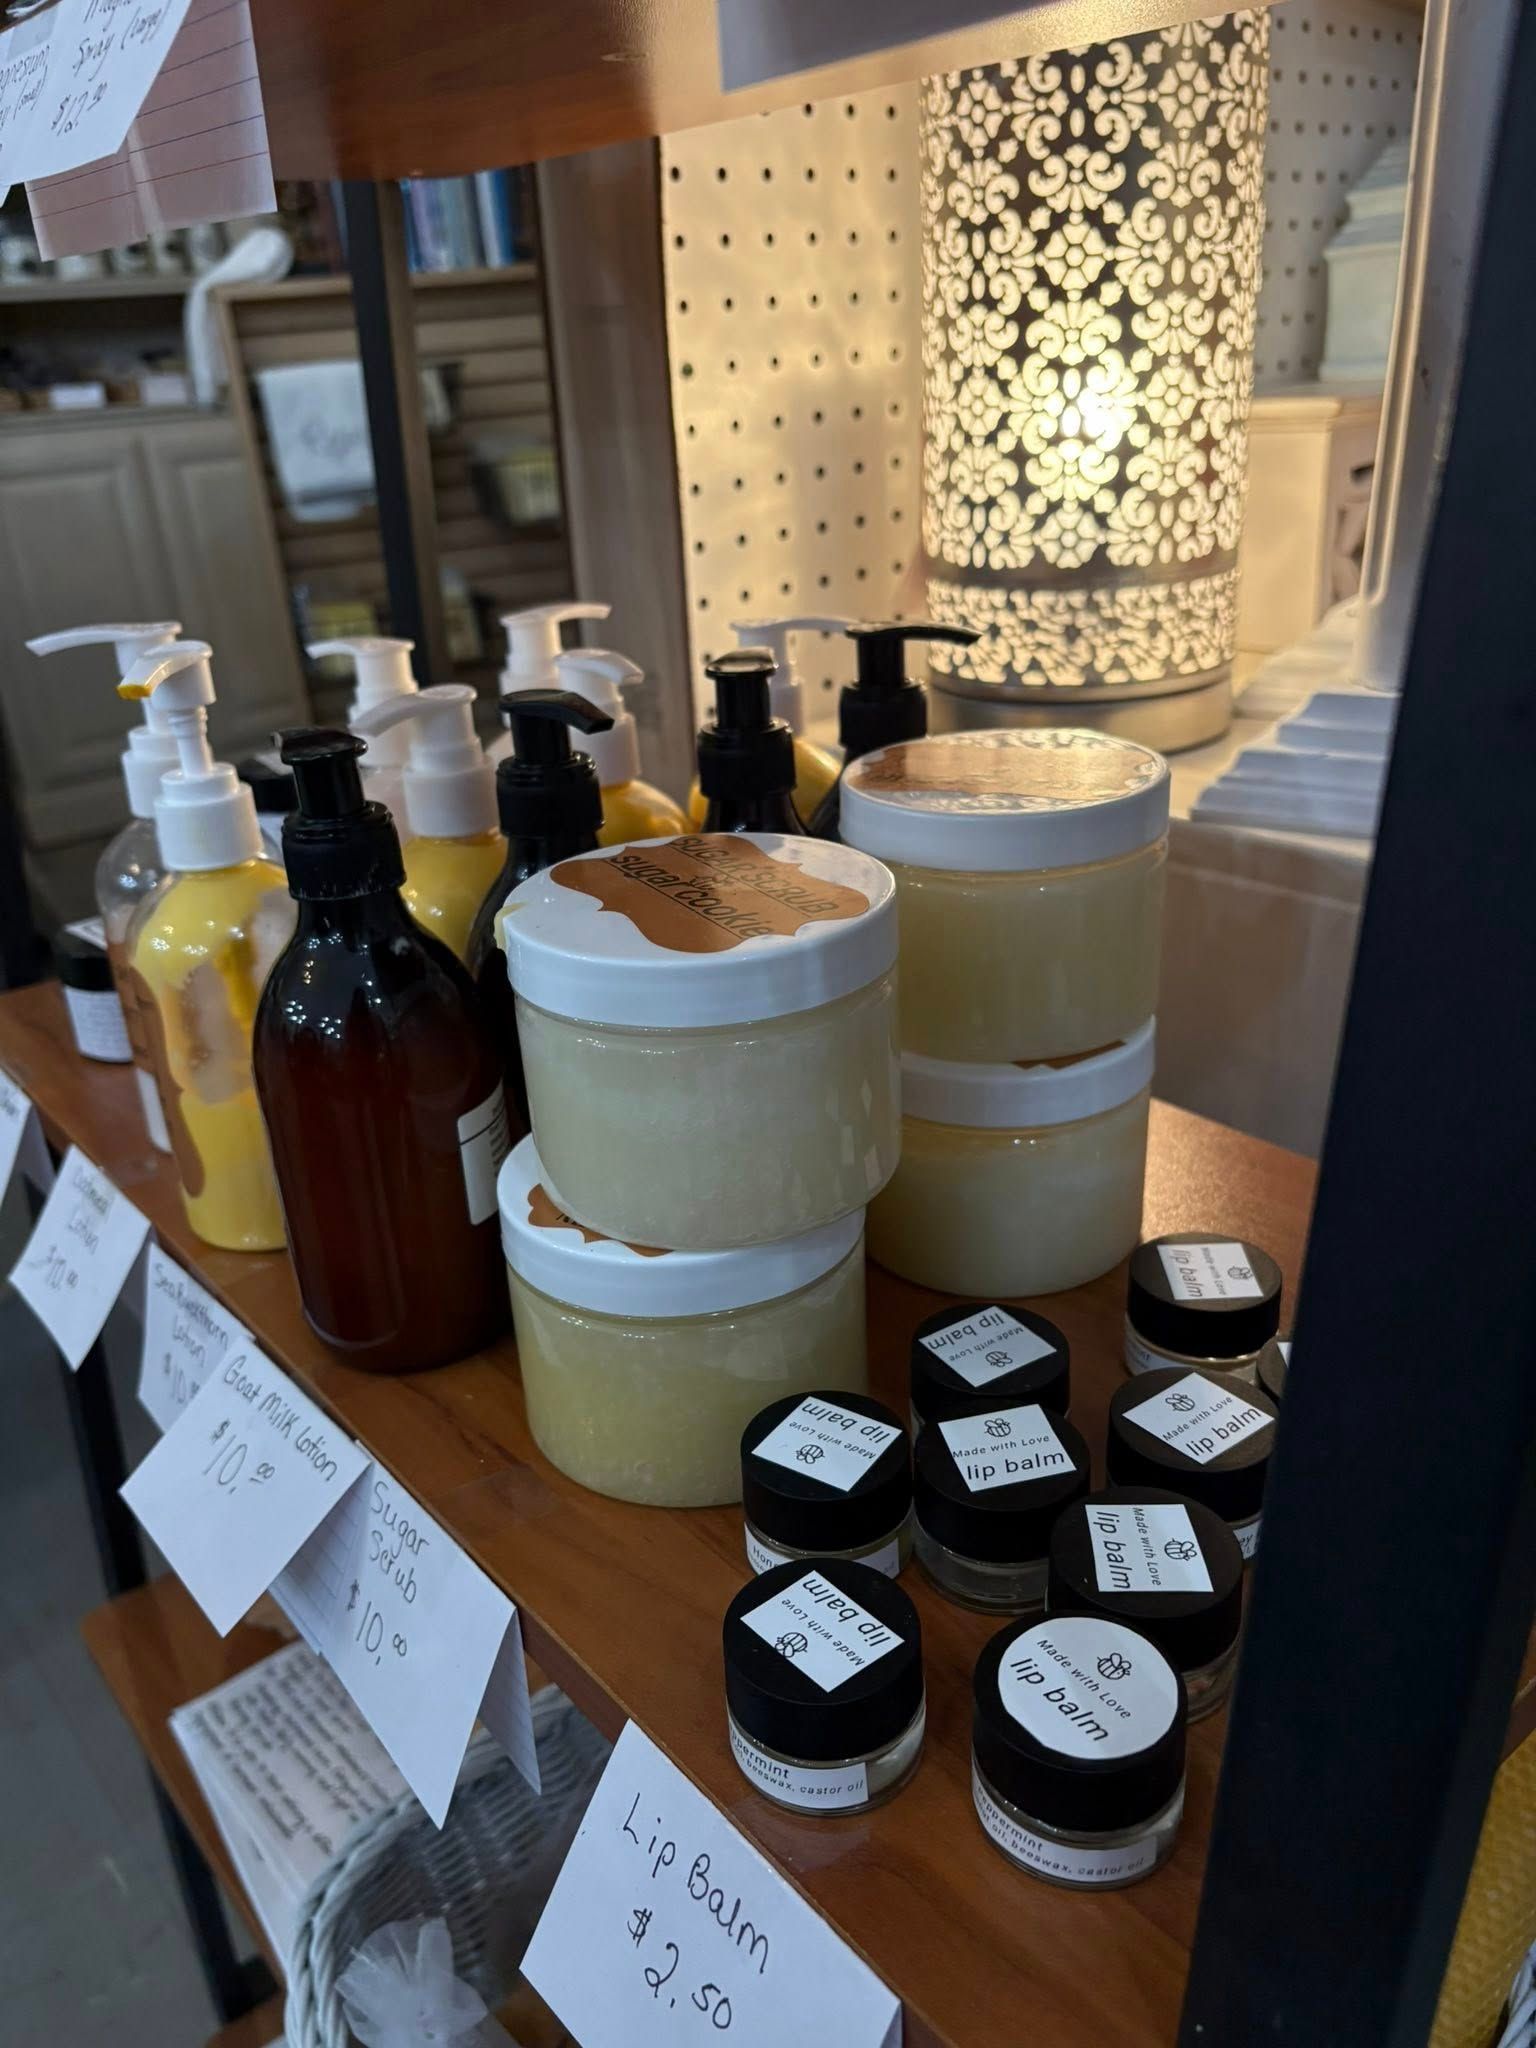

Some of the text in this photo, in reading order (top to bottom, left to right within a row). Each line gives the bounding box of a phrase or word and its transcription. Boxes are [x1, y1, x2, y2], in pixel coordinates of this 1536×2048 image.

[610, 854, 774, 938] sugar cookie
[740, 870, 839, 913] SCRUB
[1179, 1267, 1205, 1298] balm
[927, 1312, 1005, 1351] lip balm
[949, 1326, 1025, 1363] Made with Love
[223, 1354, 261, 1404] Goat
[788, 1420, 877, 1460] Made with Love
[801, 1402, 891, 1444] lip balm
[1161, 1396, 1234, 1442] Made with Love
[1185, 1407, 1262, 1458] lip balm
[952, 1434, 1051, 1459] Made with Love
[966, 1452, 1065, 1481] lip balm
[368, 1480, 430, 1557] Sugar
[368, 1529, 418, 1604] Scrub
[1093, 1511, 1133, 1590] lip balm
[1132, 1507, 1162, 1586] Made with Love
[780, 1598, 867, 1667] Made with Love
[802, 1578, 891, 1648] lip balm
[1010, 1657, 1109, 1742] lip balm
[1037, 1639, 1131, 1720] Made with Love
[746, 1760, 796, 1792] beeswax,
[800, 1785, 843, 1795] castor
[847, 1779, 864, 1792] oil
[1010, 1840, 1073, 1874] beeswax,
[1077, 1866, 1124, 1876] castor
[1127, 1857, 1145, 1872] oil
[623, 1792, 770, 1975] Lip Balm
